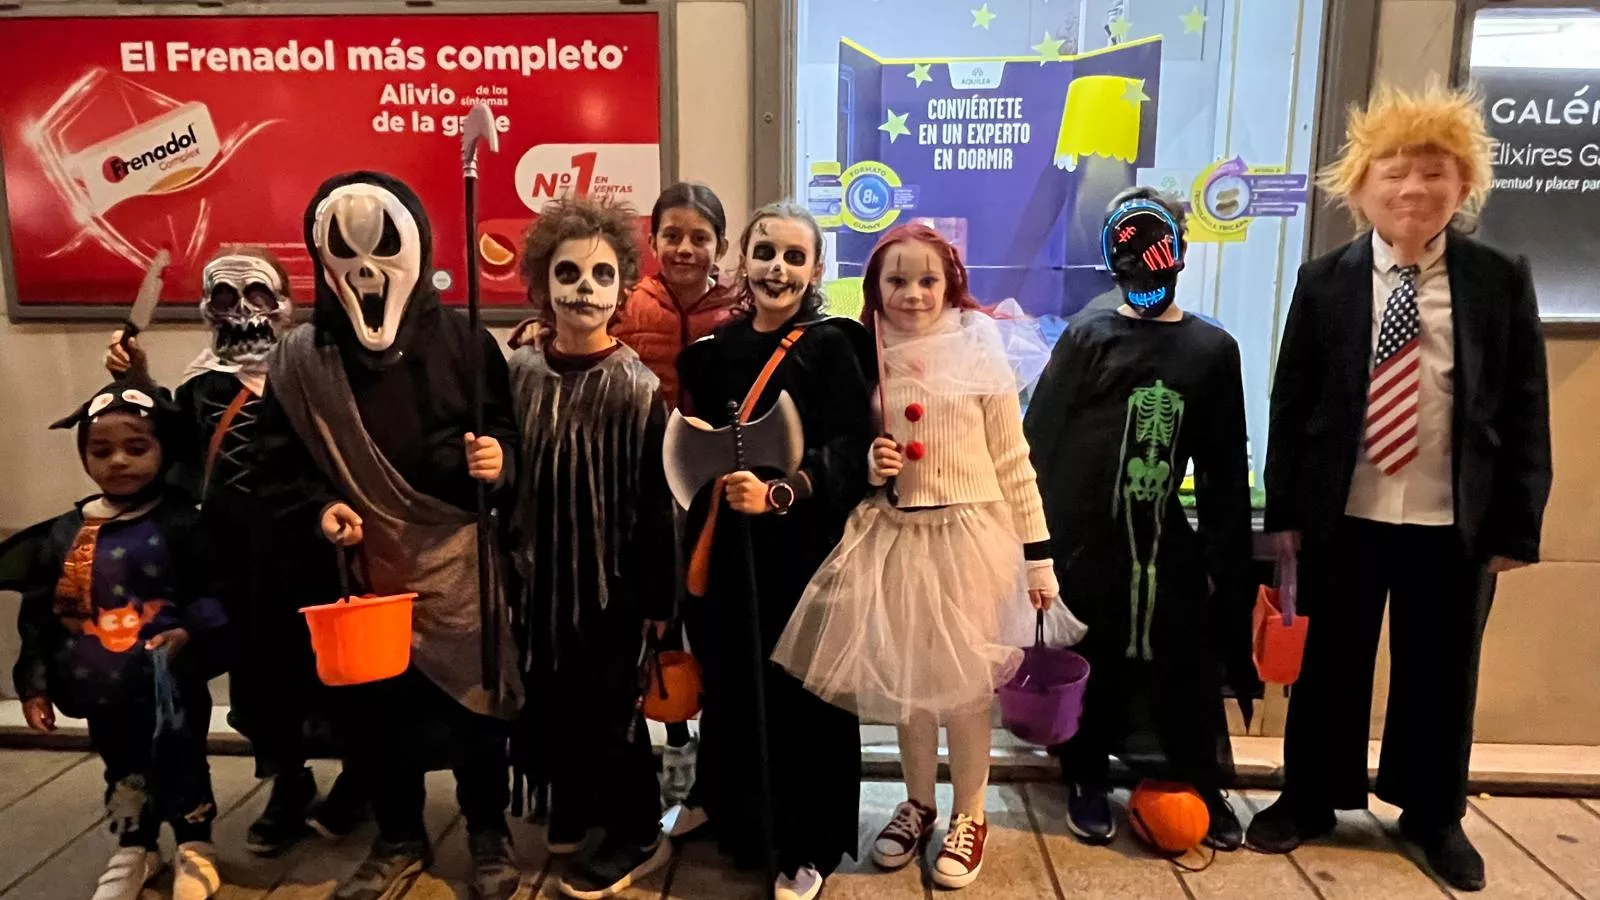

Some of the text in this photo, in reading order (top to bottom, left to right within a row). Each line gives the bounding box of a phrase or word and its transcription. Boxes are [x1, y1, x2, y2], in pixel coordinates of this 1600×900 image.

[120, 41, 155, 72] El
[166, 40, 335, 71] Frenadol
[347, 38, 426, 71] más
[379, 83, 455, 105] Alivio
[475, 85, 508, 95] de los
[927, 94, 1024, 120] CONVIÉRTETE
[372, 111, 405, 132] de
[412, 111, 435, 132] la
[918, 123, 1031, 145] EN UN EXPERTO
[110, 124, 198, 180] Frenadol
[933, 148, 1014, 170] EN DORMIR
[1487, 142, 1600, 166] Elixires G
[594, 176, 609, 184] EN
[849, 166, 887, 177] FORMATO
[593, 185, 633, 193] VENTAS
[1488, 176, 1533, 190] uventud
[1535, 180, 1543, 192] y
[1545, 176, 1580, 192] placer
[862, 189, 879, 204] 8h
